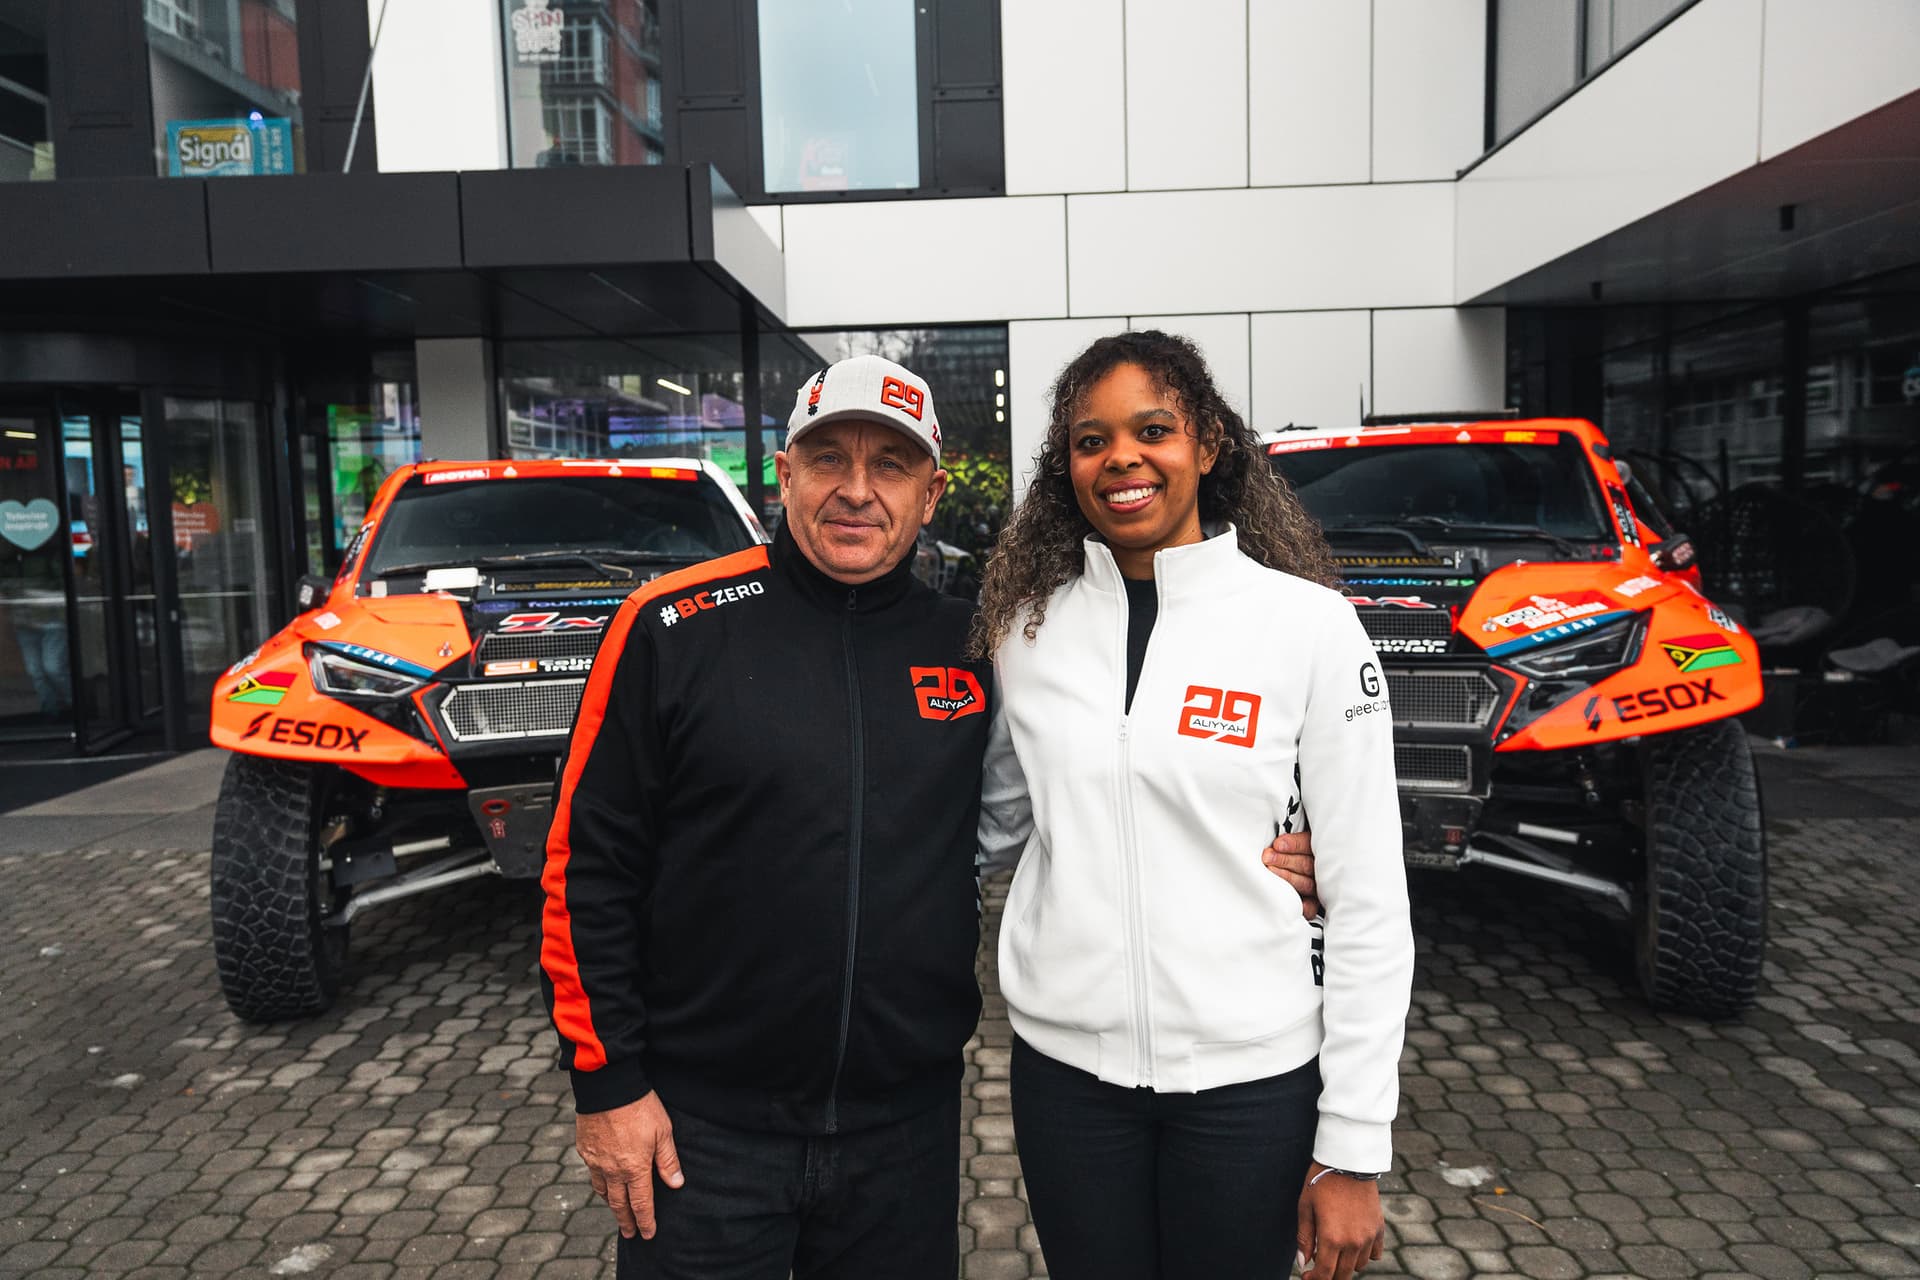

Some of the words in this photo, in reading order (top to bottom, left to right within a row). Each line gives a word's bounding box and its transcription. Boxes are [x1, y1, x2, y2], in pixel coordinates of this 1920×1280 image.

[180, 134, 252, 168] Signál
[881, 376, 924, 421] 29
[660, 582, 764, 627] #BCZERO
[910, 666, 986, 720] 29
[930, 695, 975, 710] ALIYYAH
[1612, 677, 1727, 723] ESOX
[269, 717, 370, 752] ESOX
[1178, 685, 1262, 748] 29
[1193, 718, 1246, 734] ALIYYAH
